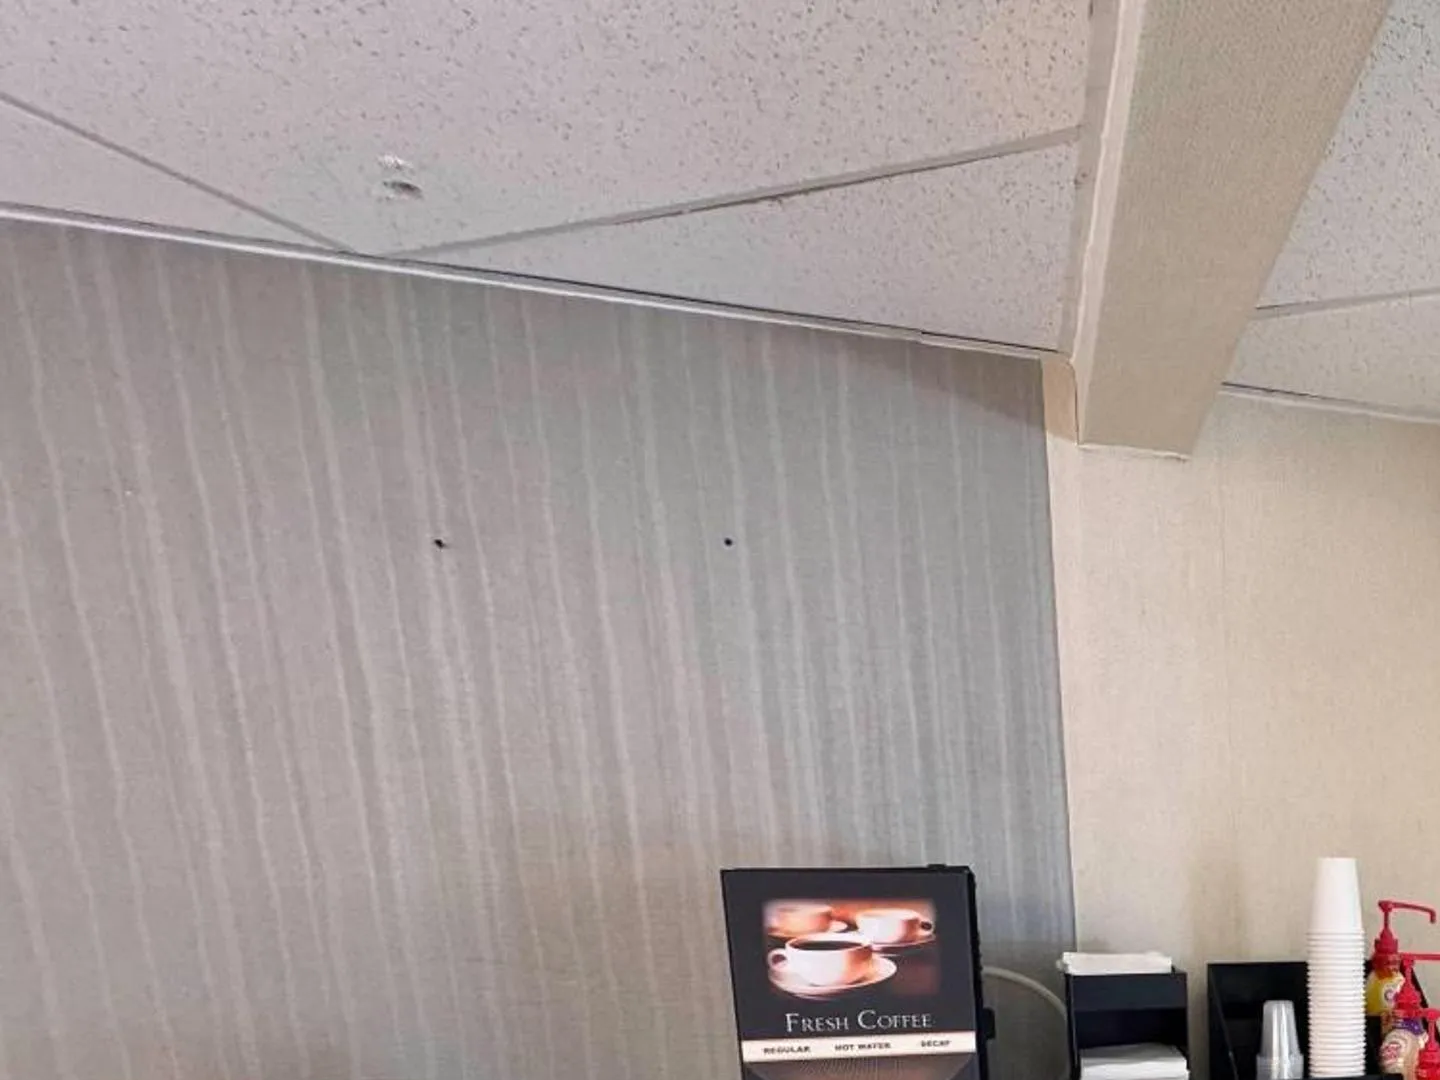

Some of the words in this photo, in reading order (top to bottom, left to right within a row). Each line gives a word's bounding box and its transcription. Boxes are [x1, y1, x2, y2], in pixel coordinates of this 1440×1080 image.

[784, 1012, 849, 1033] FRESH
[857, 1009, 932, 1029] COFFEE
[763, 1045, 811, 1056] REGULAR
[834, 1043, 854, 1051] HOT
[858, 1041, 891, 1050] WATER
